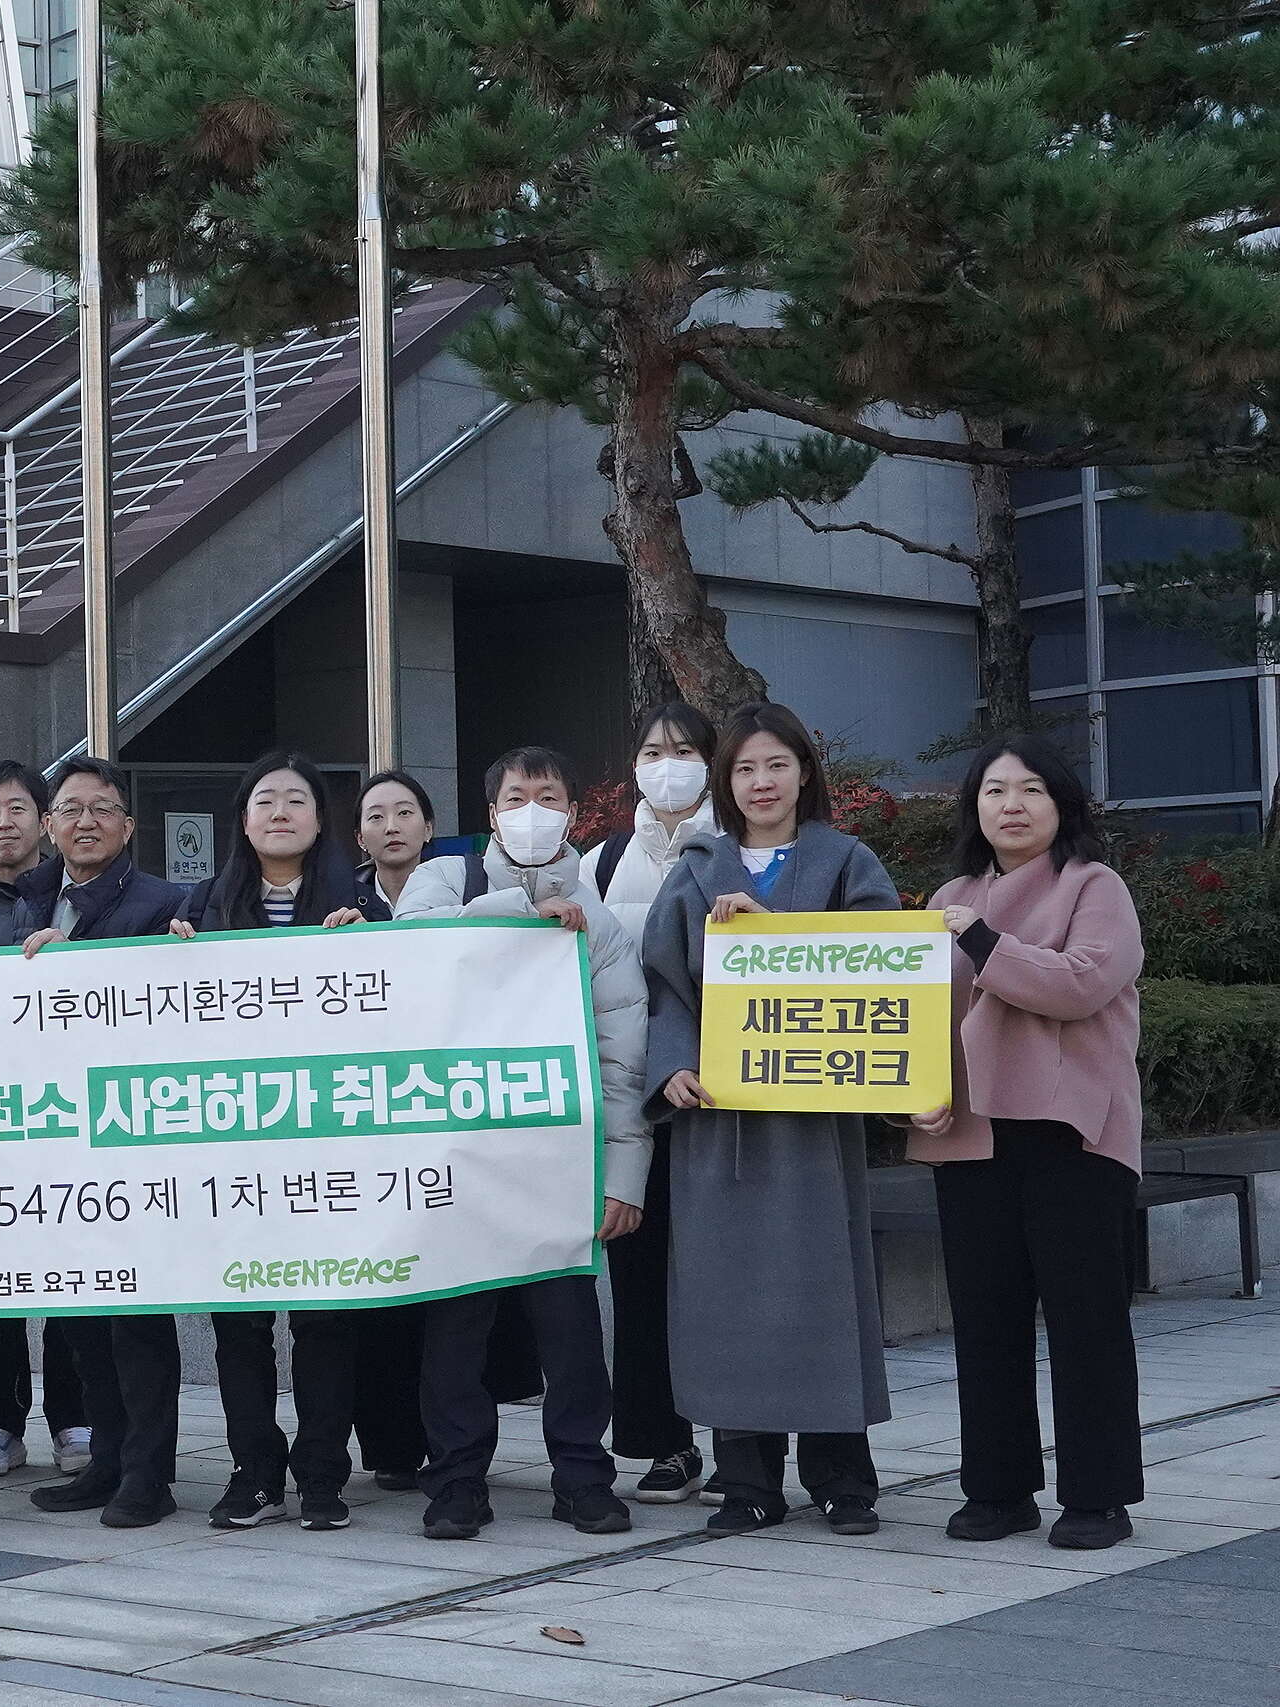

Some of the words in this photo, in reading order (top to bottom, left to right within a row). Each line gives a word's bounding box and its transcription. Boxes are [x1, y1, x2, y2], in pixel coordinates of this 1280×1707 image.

[722, 943, 934, 977] GREENPEACE
[12, 975, 304, 1032] 기후에너지환경부
[315, 969, 392, 1015] 장관
[741, 997, 909, 1034] 새로고침
[741, 1049, 910, 1086] 네트워크
[96, 1068, 318, 1136] 사업허가
[332, 1058, 571, 1127] 취소하라
[142, 1176, 179, 1220] 제
[201, 1173, 269, 1218] 1차
[283, 1170, 361, 1214] 변론
[376, 1164, 455, 1211] 기일
[42, 1270, 86, 1295] 요구
[93, 1267, 137, 1293] 모임
[223, 1254, 420, 1293] GREENPEACE
